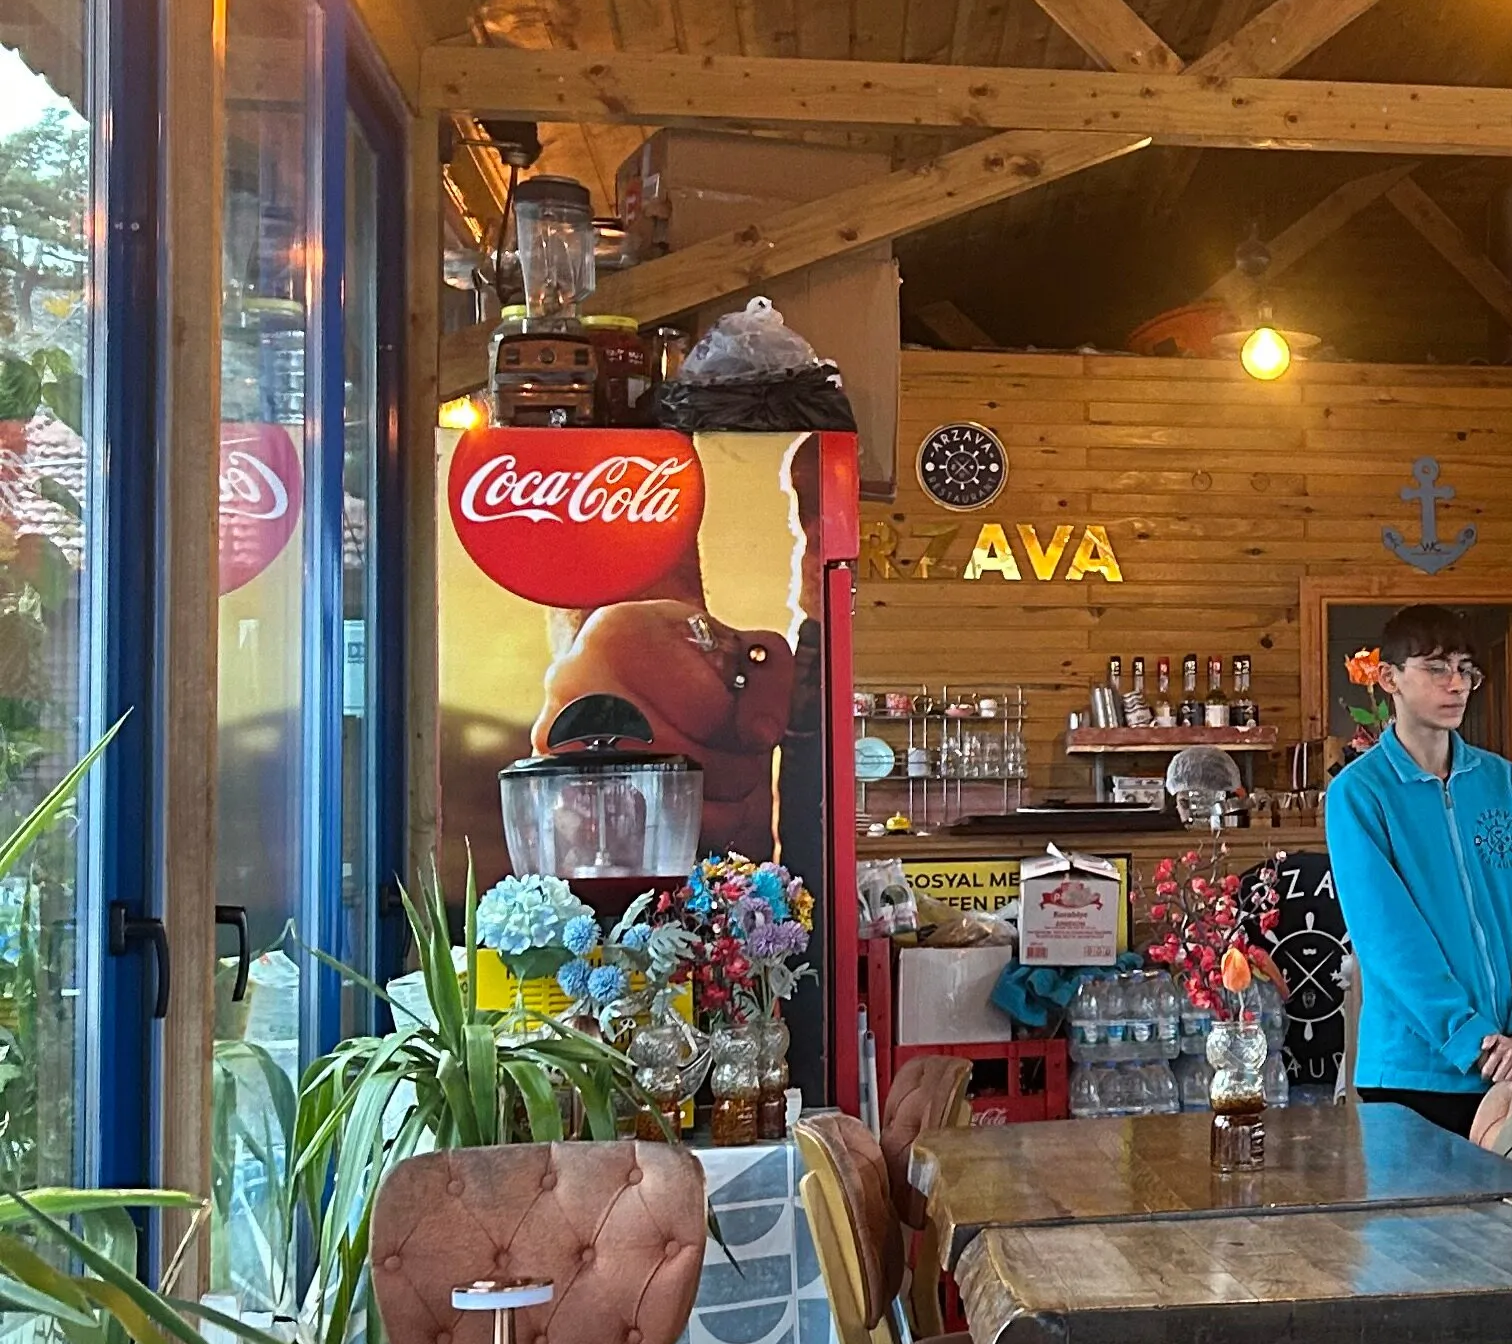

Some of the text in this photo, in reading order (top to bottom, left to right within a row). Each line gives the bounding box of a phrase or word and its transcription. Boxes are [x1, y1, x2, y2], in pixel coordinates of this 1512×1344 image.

[932, 429, 992, 453] ARZAVA
[461, 454, 693, 523] Coca-Cola
[905, 873, 984, 888] SOSYAL
